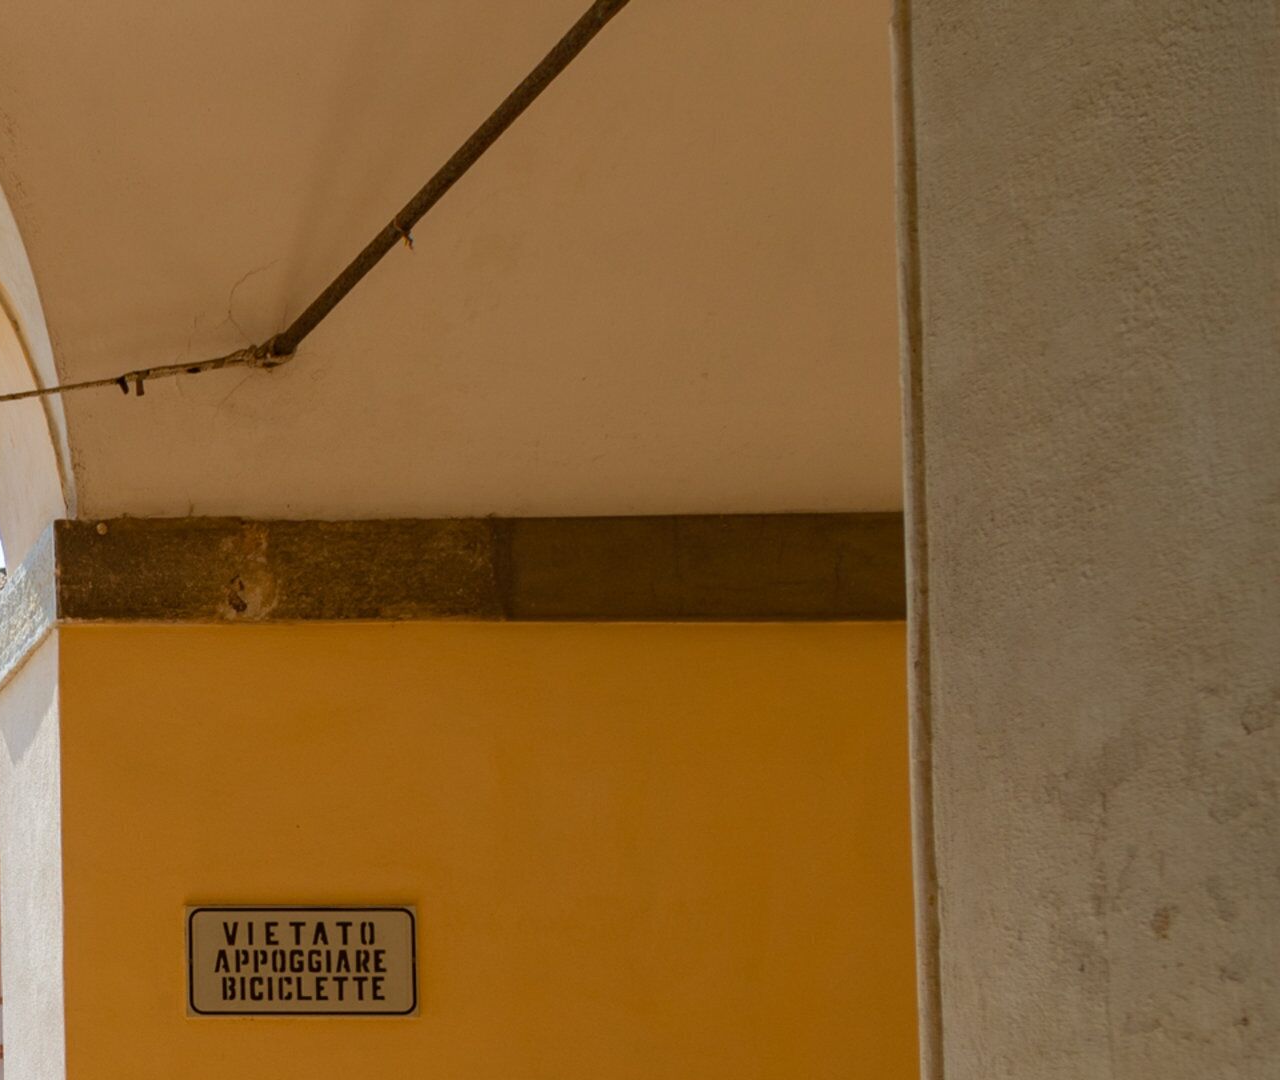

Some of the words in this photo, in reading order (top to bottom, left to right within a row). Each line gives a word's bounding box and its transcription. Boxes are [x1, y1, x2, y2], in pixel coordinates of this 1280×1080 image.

[223, 921, 375, 946] VIETATO
[214, 949, 387, 973] APPOGGIARE
[221, 976, 385, 1001] BICICLETTE
